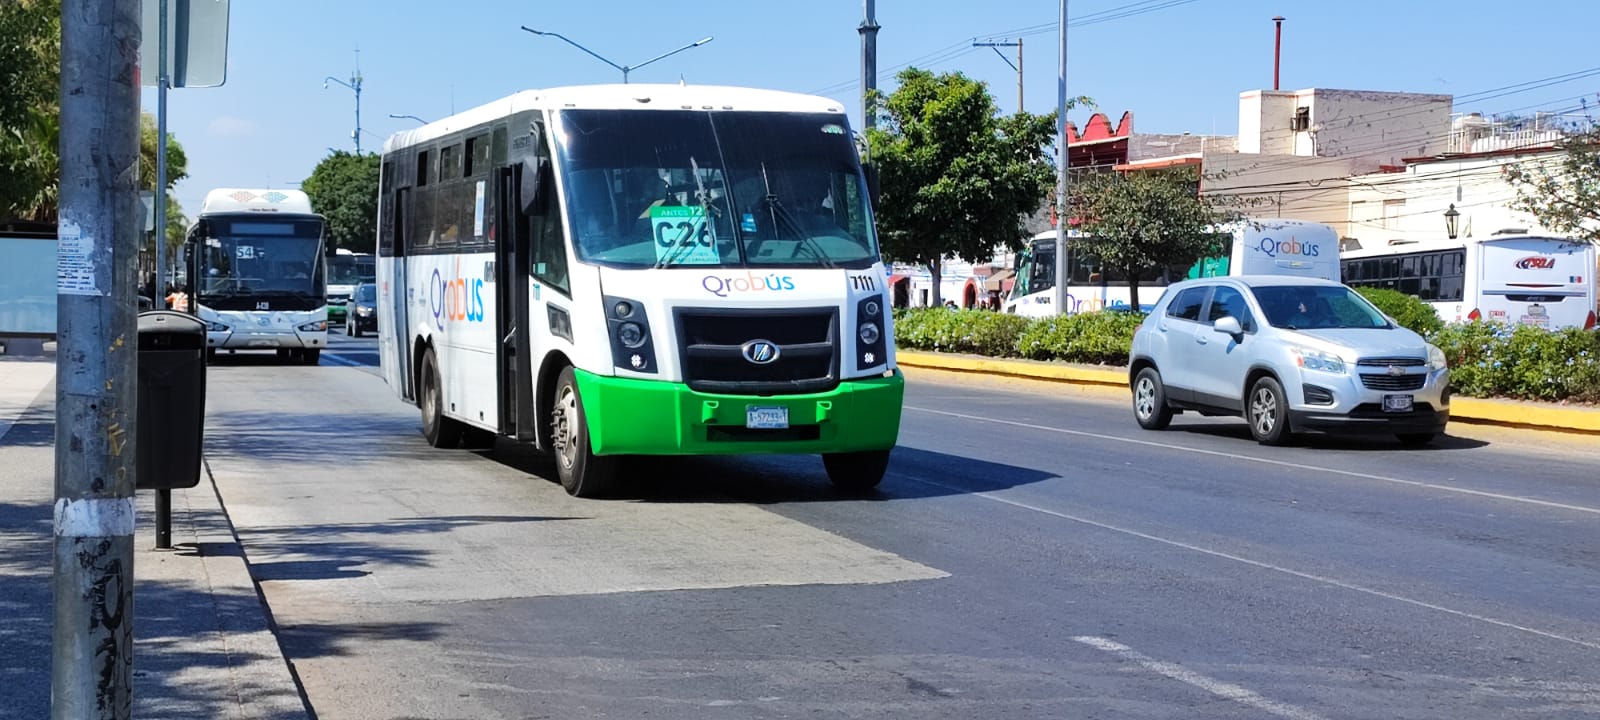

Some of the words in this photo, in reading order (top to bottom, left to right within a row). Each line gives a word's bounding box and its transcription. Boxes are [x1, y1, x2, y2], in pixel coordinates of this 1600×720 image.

[655, 221, 716, 248] C26
[1260, 235, 1320, 258] Qrobús
[430, 256, 484, 332] Qrobus
[702, 271, 796, 298] Qrobús
[849, 275, 876, 292] 7111
